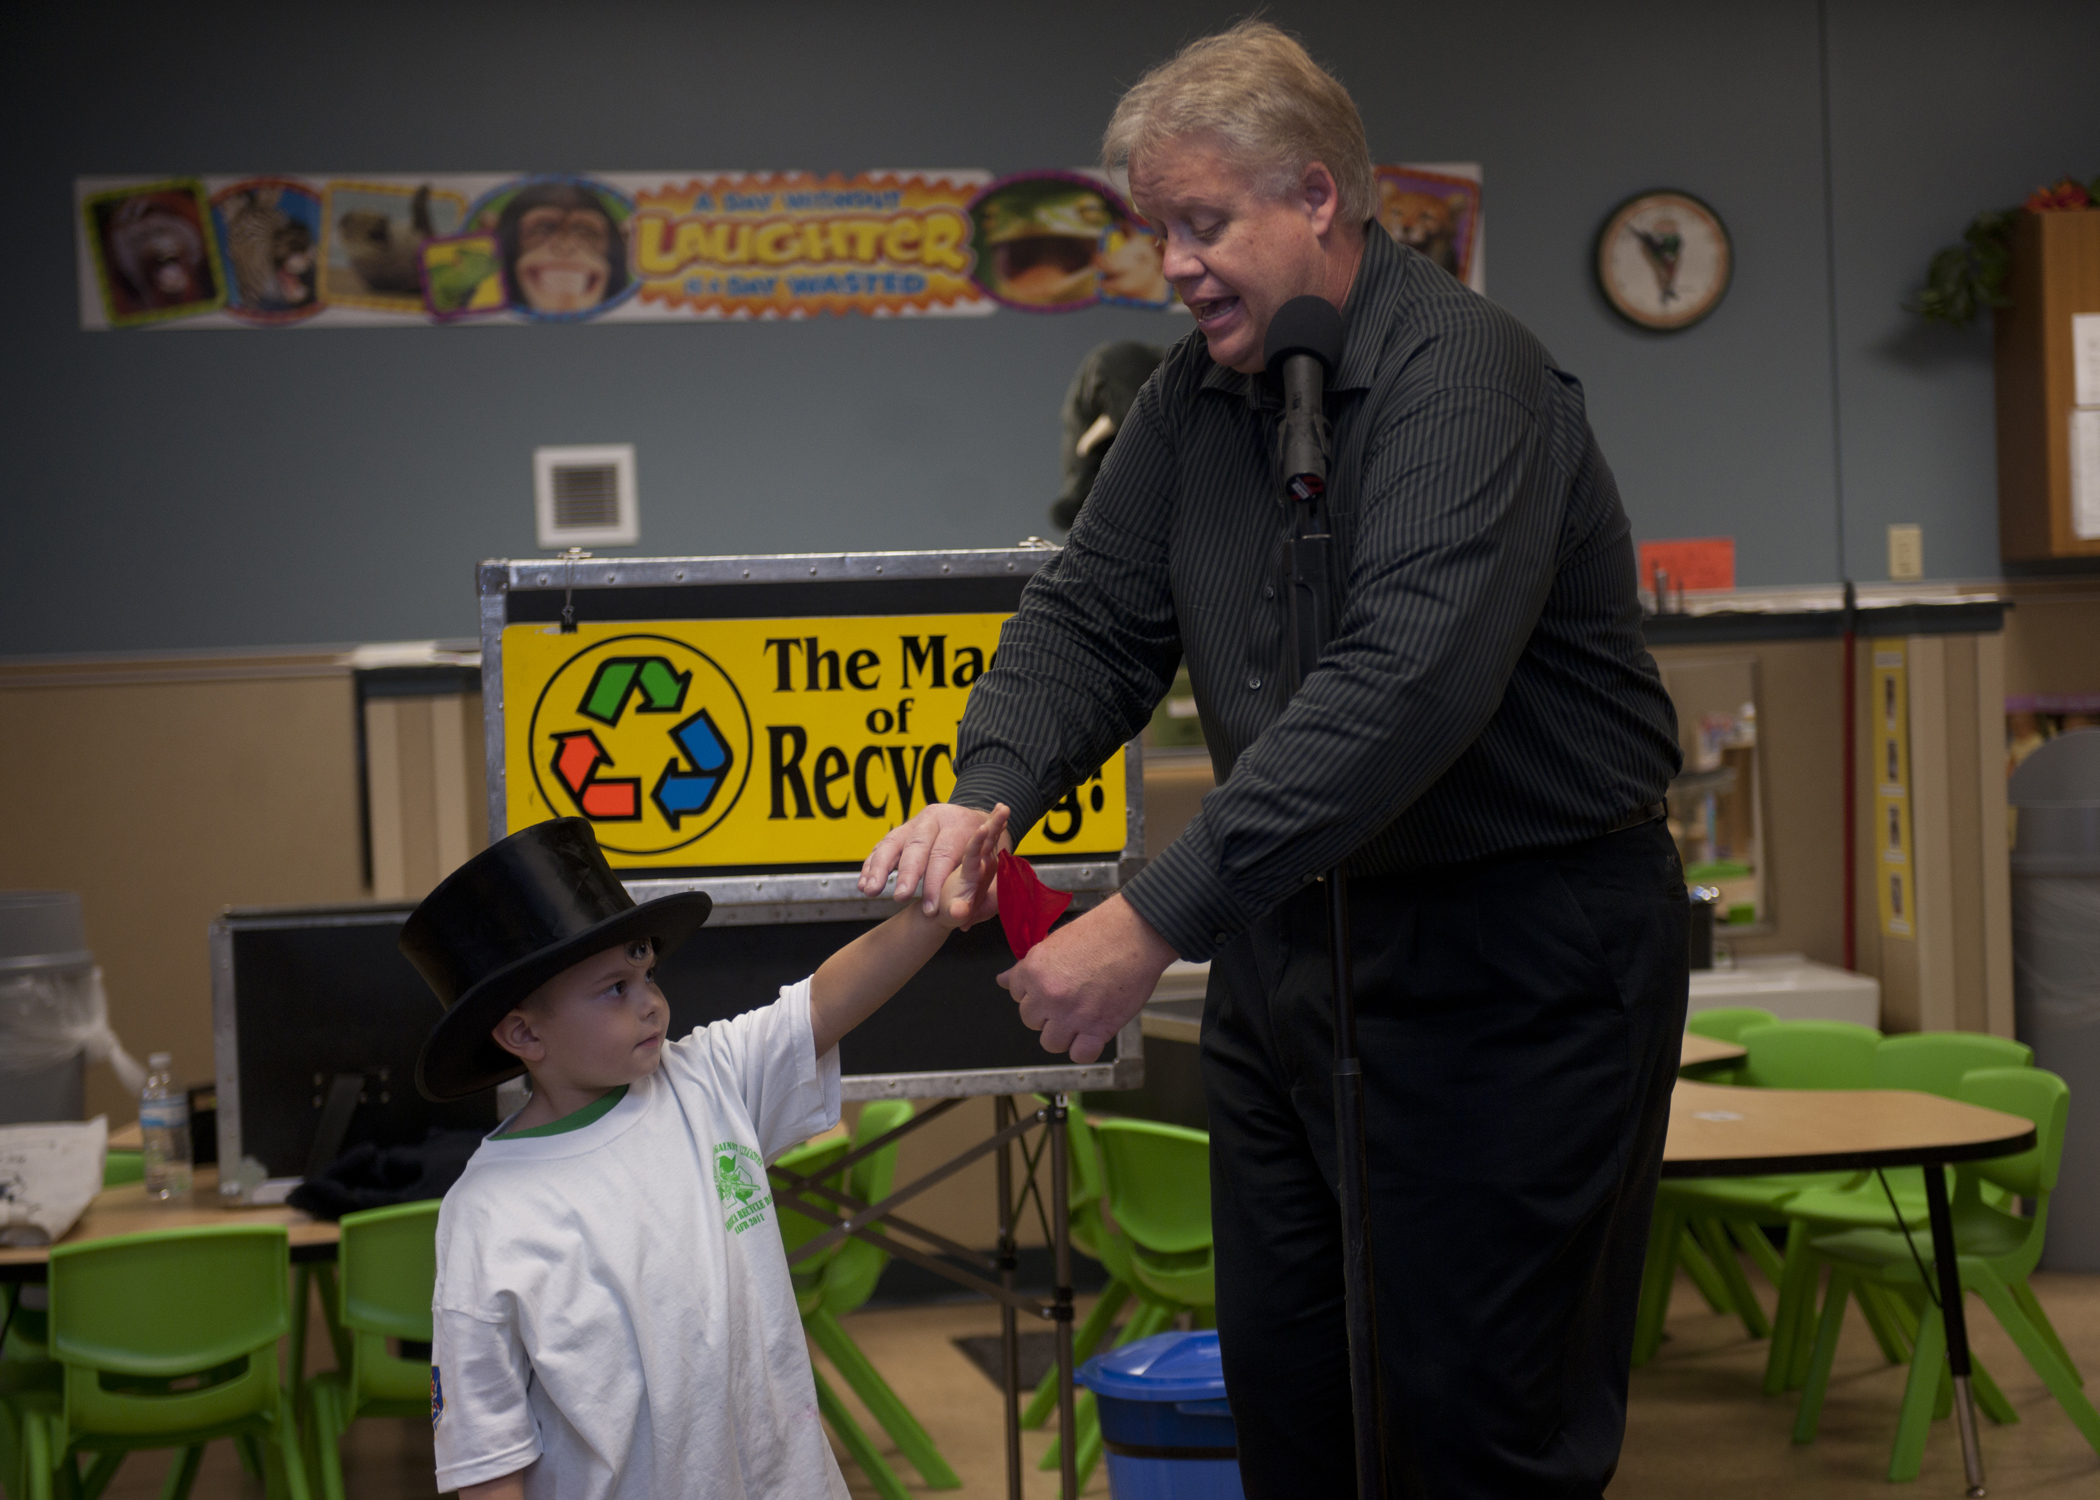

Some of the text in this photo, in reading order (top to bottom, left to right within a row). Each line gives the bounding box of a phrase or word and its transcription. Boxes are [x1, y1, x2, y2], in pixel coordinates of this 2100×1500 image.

[637, 213, 969, 272] LAUGHTER
[786, 274, 925, 296] WASTED
[763, 637, 881, 692] The
[866, 698, 914, 734] of
[713, 1141, 738, 1155] GAINST
[748, 1213, 765, 1226] 2011
